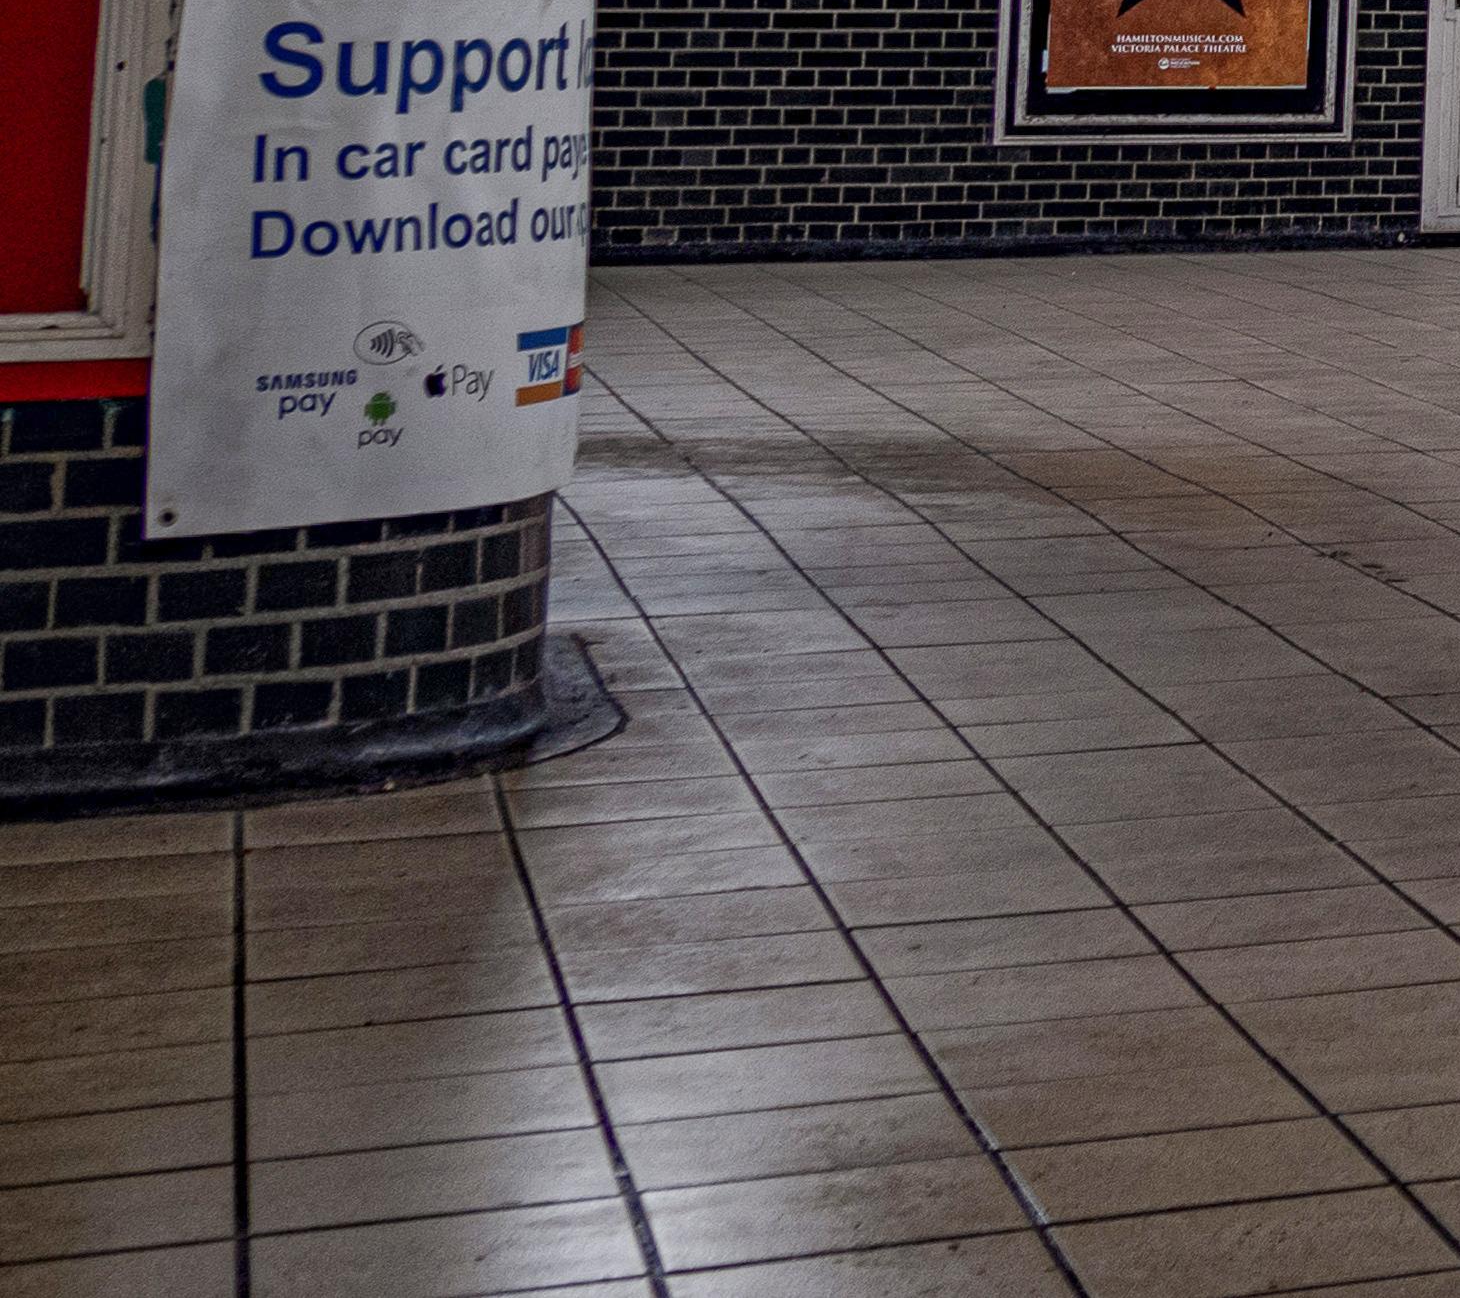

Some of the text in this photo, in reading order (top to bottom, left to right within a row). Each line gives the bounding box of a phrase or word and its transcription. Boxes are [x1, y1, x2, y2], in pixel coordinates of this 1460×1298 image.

[1111, 44, 1248, 53] VICTORIA PALACE THEATRE
[1116, 34, 1244, 44] HAMILTONMUSICAL.COM
[258, 20, 570, 114] Support
[253, 134, 310, 183] In
[336, 140, 427, 181] car
[444, 124, 533, 176] card
[250, 197, 520, 260] Download
[531, 202, 576, 243] our
[255, 369, 358, 393] SAMSUNG
[527, 350, 561, 382] VISA
[451, 364, 496, 402] Pay
[278, 391, 337, 420] pay
[357, 427, 403, 449] pay
